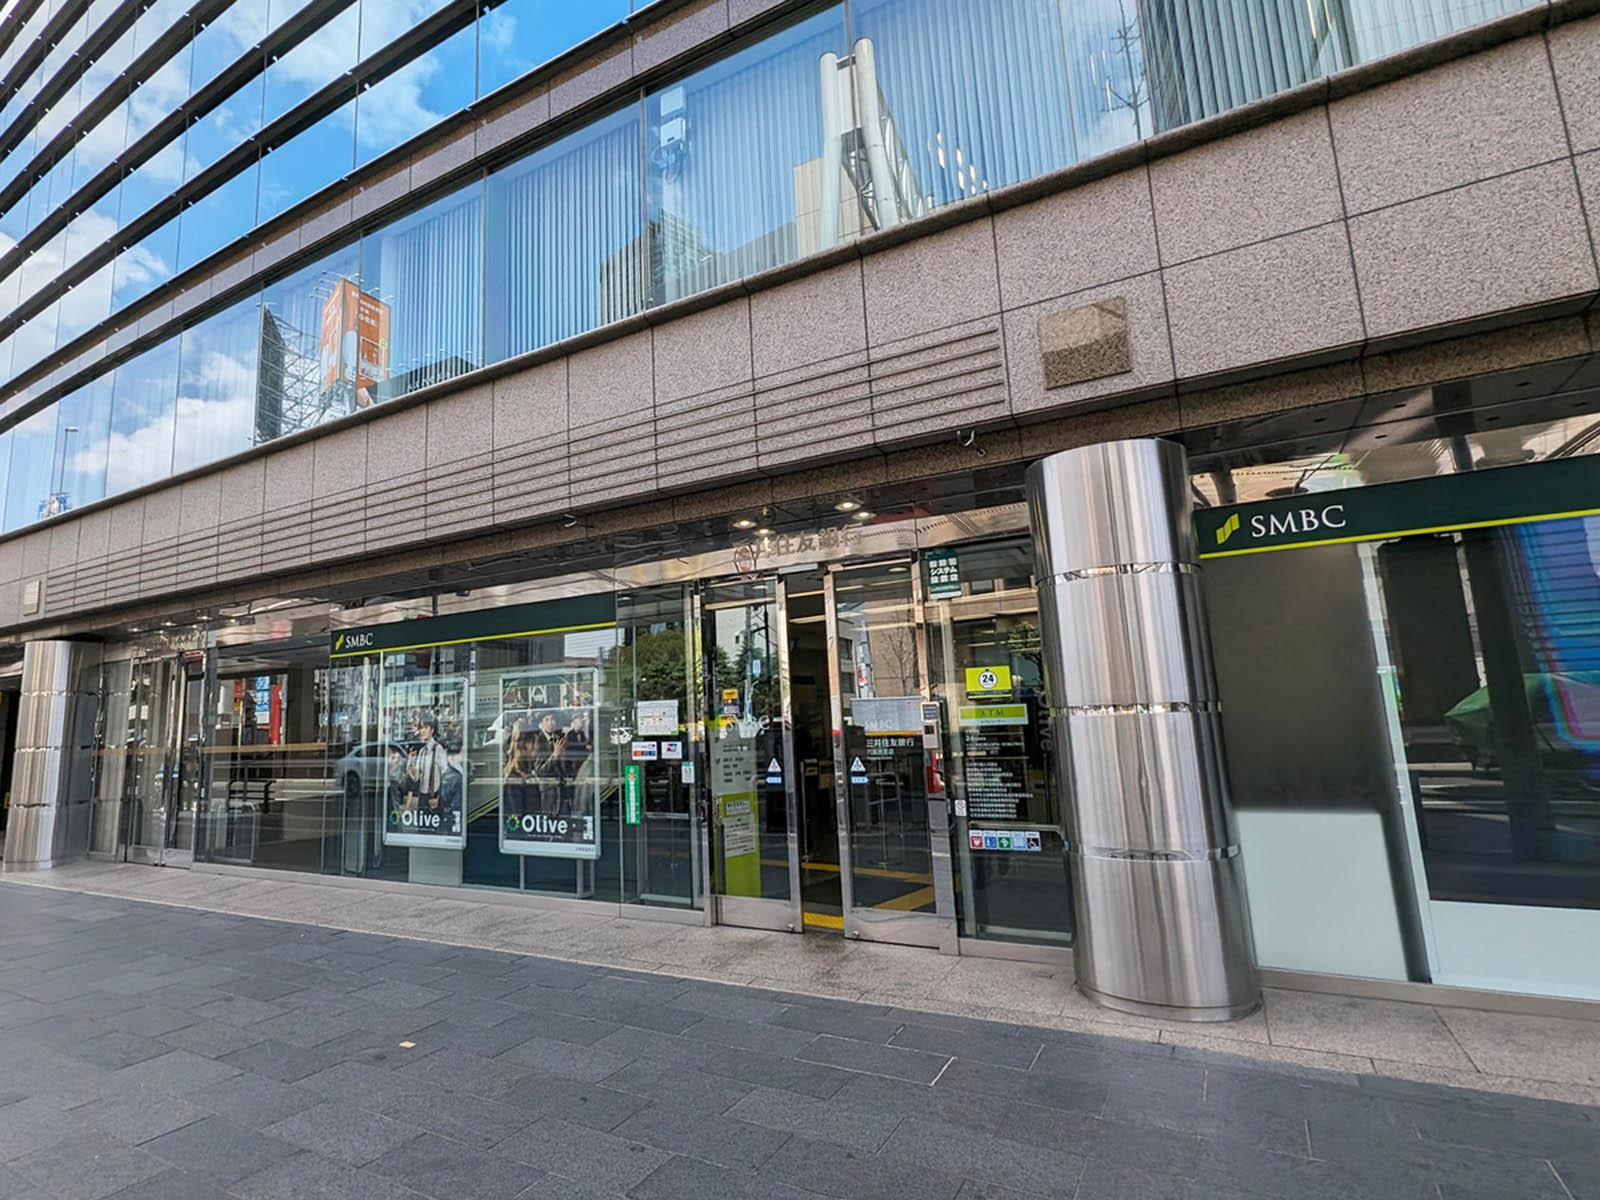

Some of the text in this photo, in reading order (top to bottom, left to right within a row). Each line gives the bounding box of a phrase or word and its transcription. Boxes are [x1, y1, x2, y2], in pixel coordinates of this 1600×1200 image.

[1251, 505, 1346, 537] SMBC
[345, 632, 374, 648] SMBC
[982, 674, 994, 684] 24
[402, 810, 440, 827] Olive
[522, 815, 568, 834] Olive
